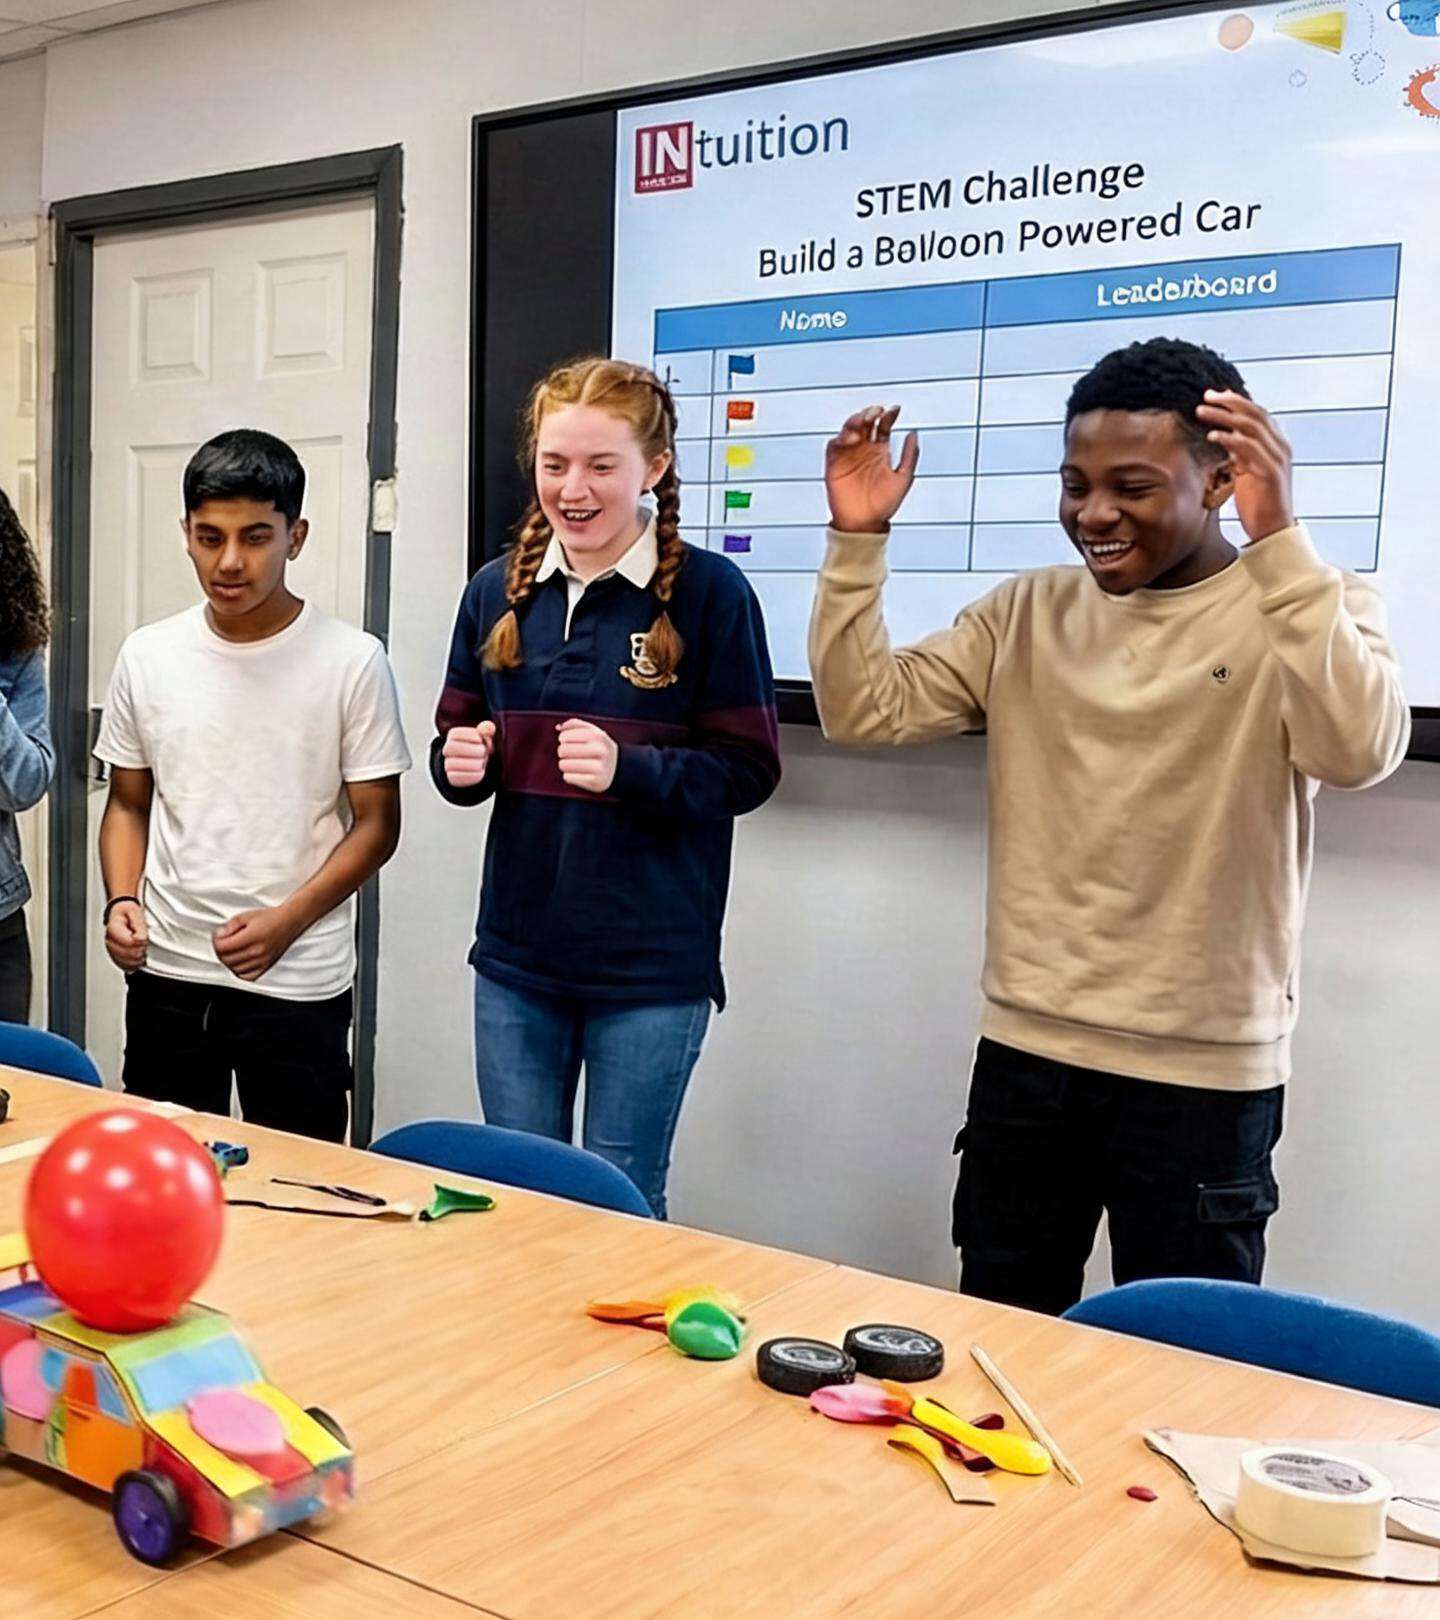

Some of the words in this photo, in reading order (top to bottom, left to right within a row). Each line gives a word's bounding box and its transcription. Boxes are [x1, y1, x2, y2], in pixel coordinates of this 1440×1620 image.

[856, 178, 952, 219] STEM
[963, 162, 1145, 206] Challenge
[759, 237, 836, 278] Build
[846, 245, 864, 269] a
[1019, 201, 1182, 252] Powered
[1195, 200, 1262, 233] Car
